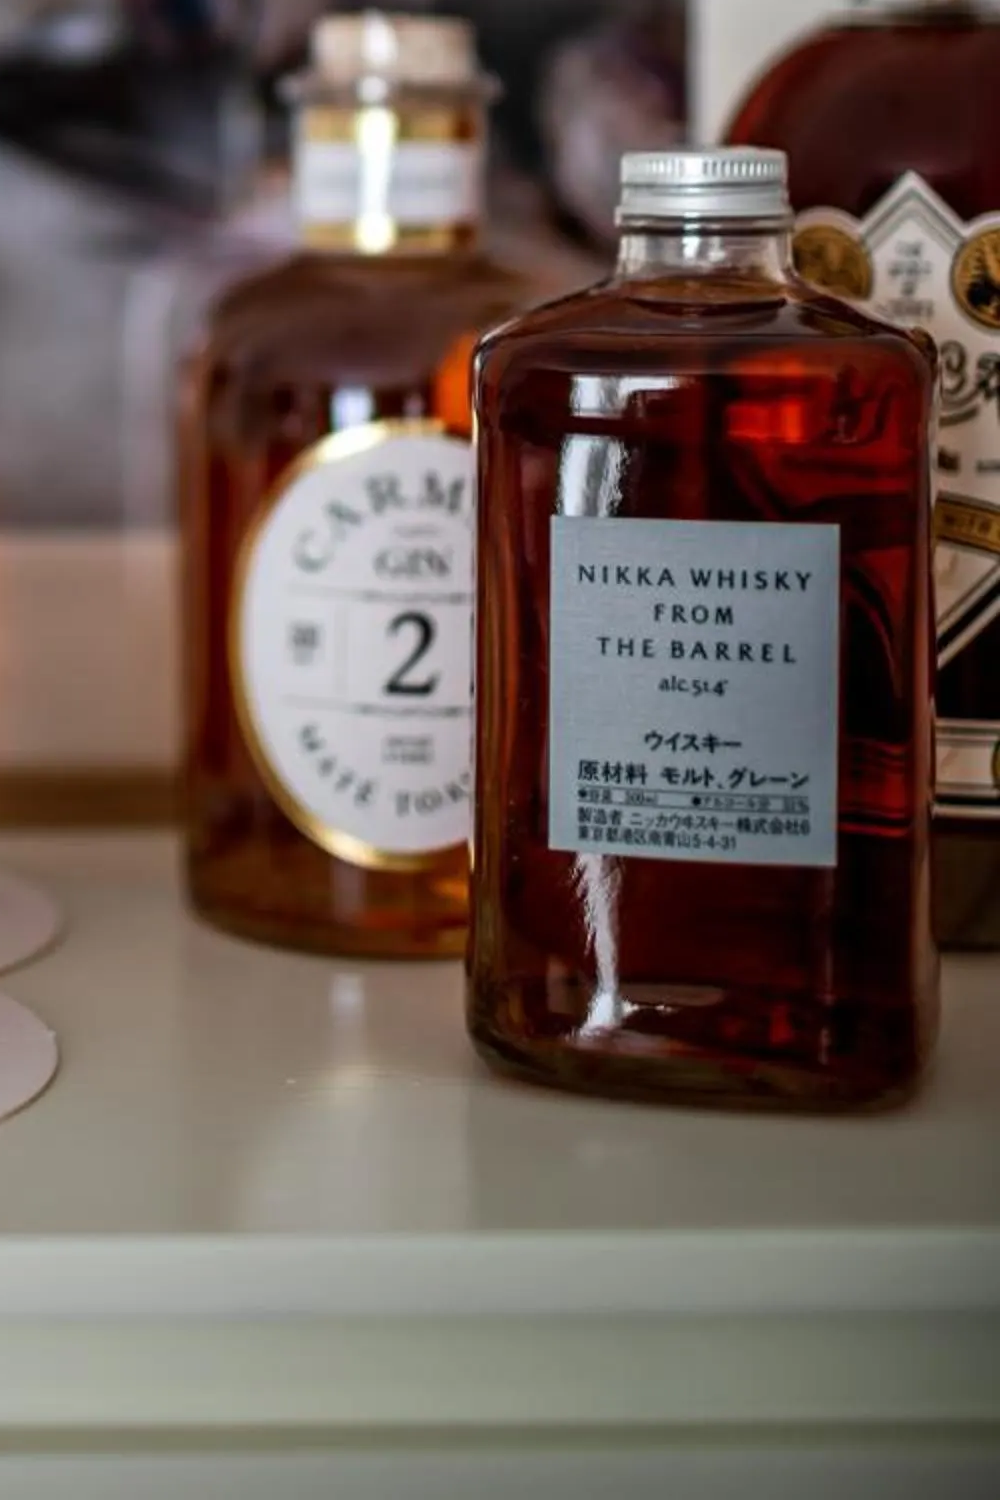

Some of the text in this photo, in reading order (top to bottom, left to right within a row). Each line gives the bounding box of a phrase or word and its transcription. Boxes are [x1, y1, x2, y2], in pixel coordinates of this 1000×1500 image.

[291, 469, 474, 575] CARM
[372, 545, 453, 577] GIN
[577, 564, 813, 592] NIKKA WHISKY
[653, 603, 734, 626] FROM
[384, 610, 441, 698] 2
[597, 636, 797, 664] THE BARREL
[643, 730, 742, 755] ウイスキー
[577, 758, 648, 786] 原材料
